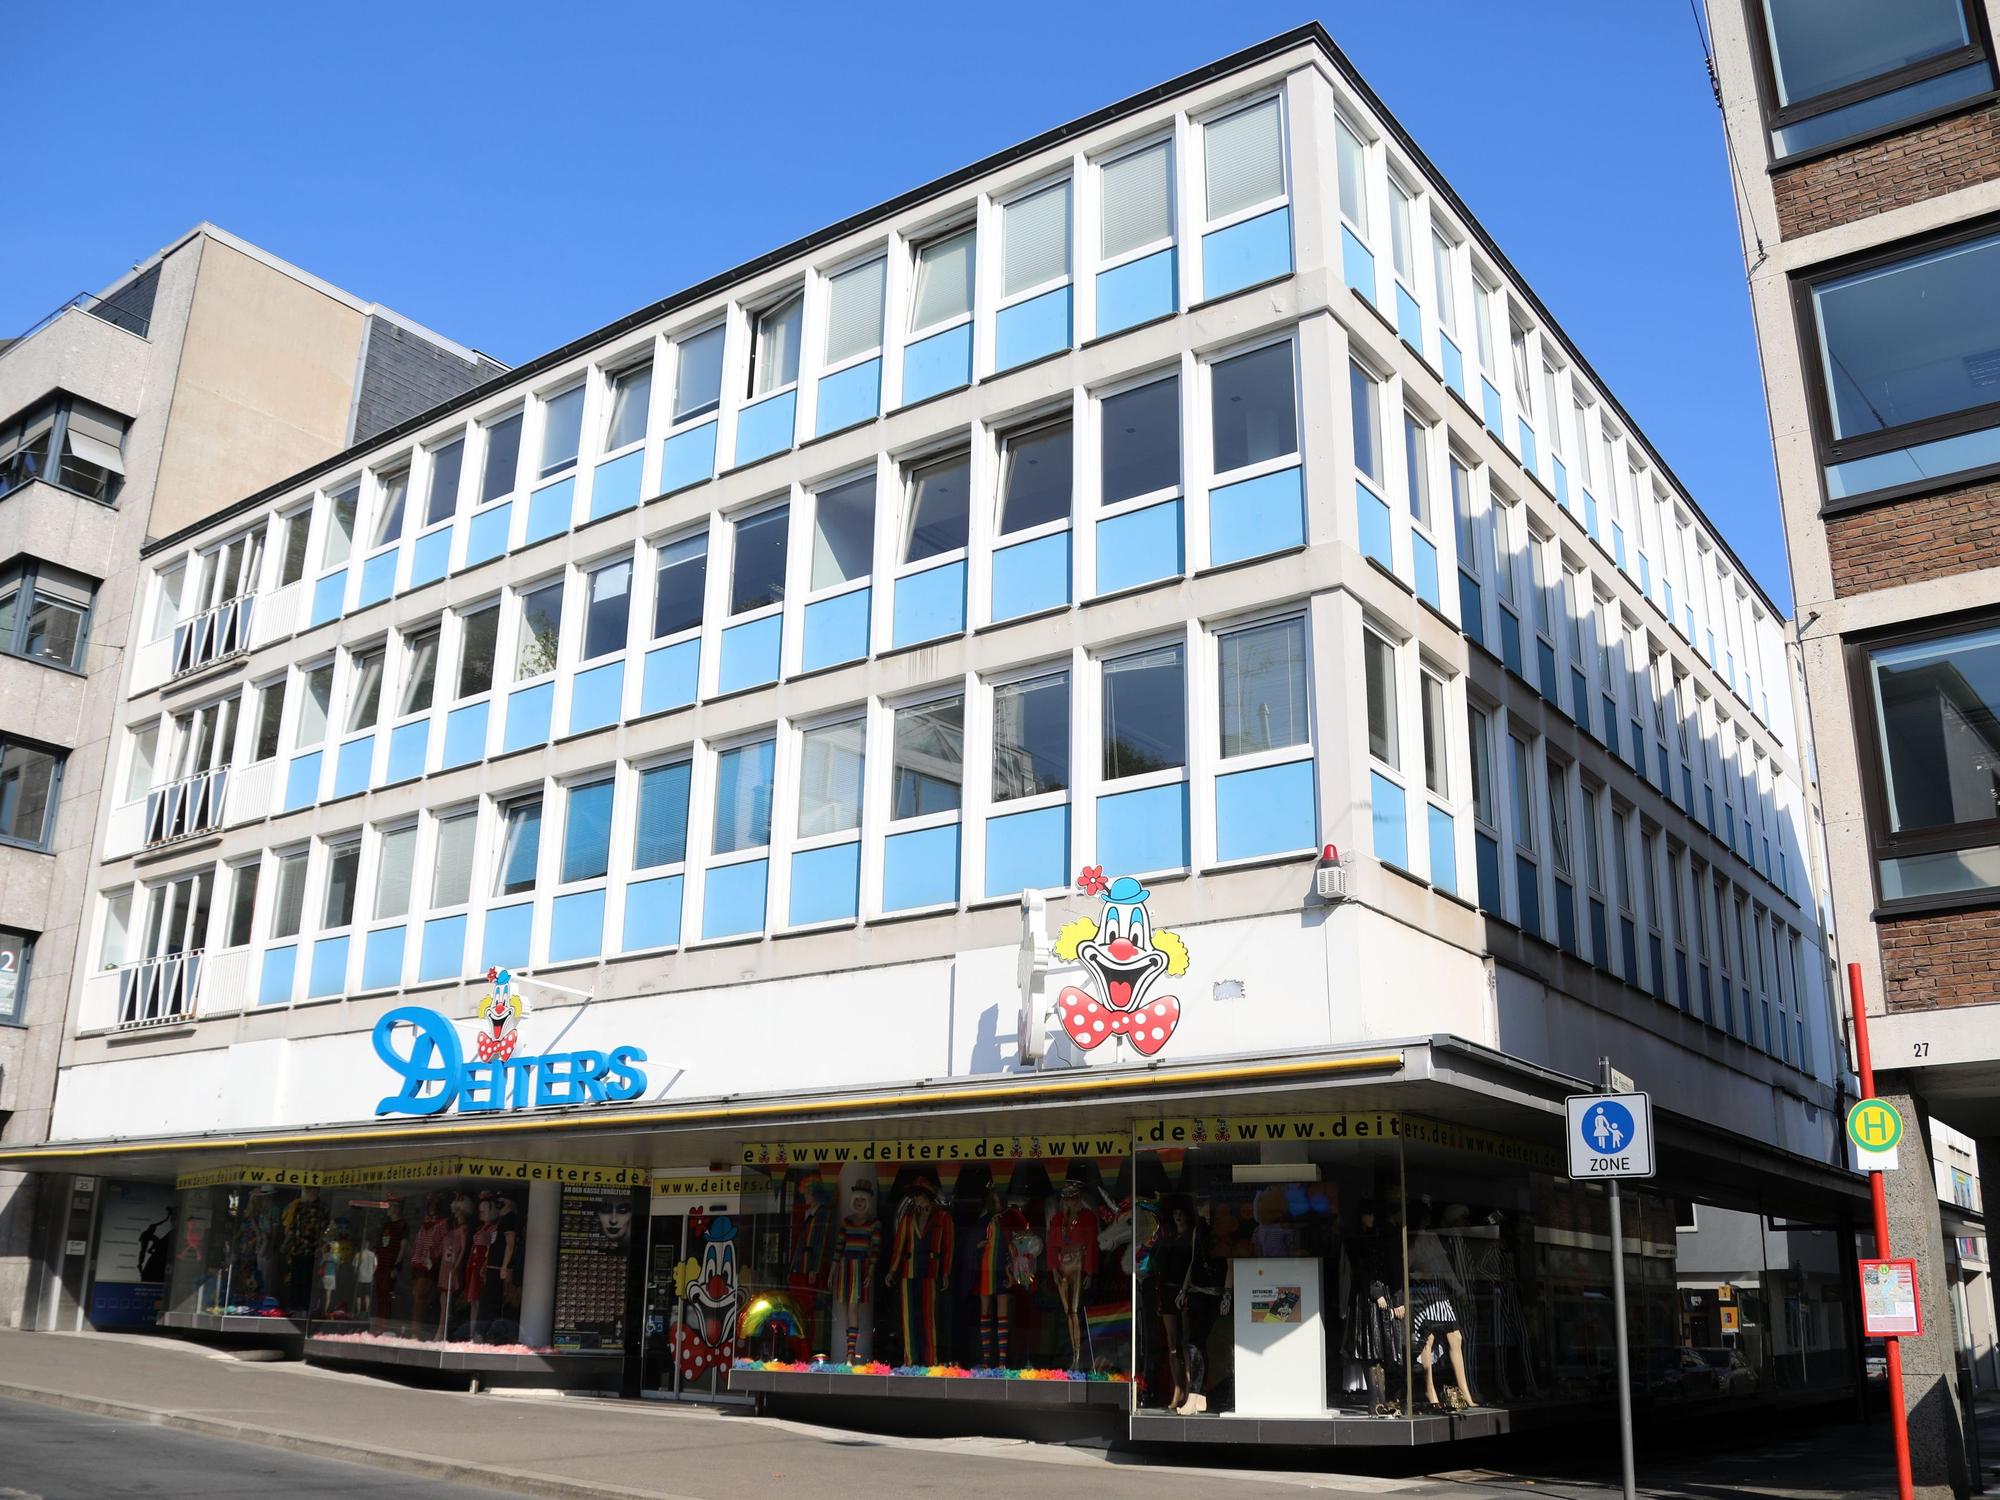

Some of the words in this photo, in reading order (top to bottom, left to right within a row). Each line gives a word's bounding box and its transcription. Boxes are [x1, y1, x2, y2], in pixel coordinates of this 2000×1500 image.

[1913, 1042, 1930, 1058] 27
[1863, 1111, 1887, 1141] H
[793, 1139, 1005, 1162] www.deiters.de
[454, 1163, 640, 1184] www.deiters.de
[1590, 1157, 1630, 1171] ZONE
